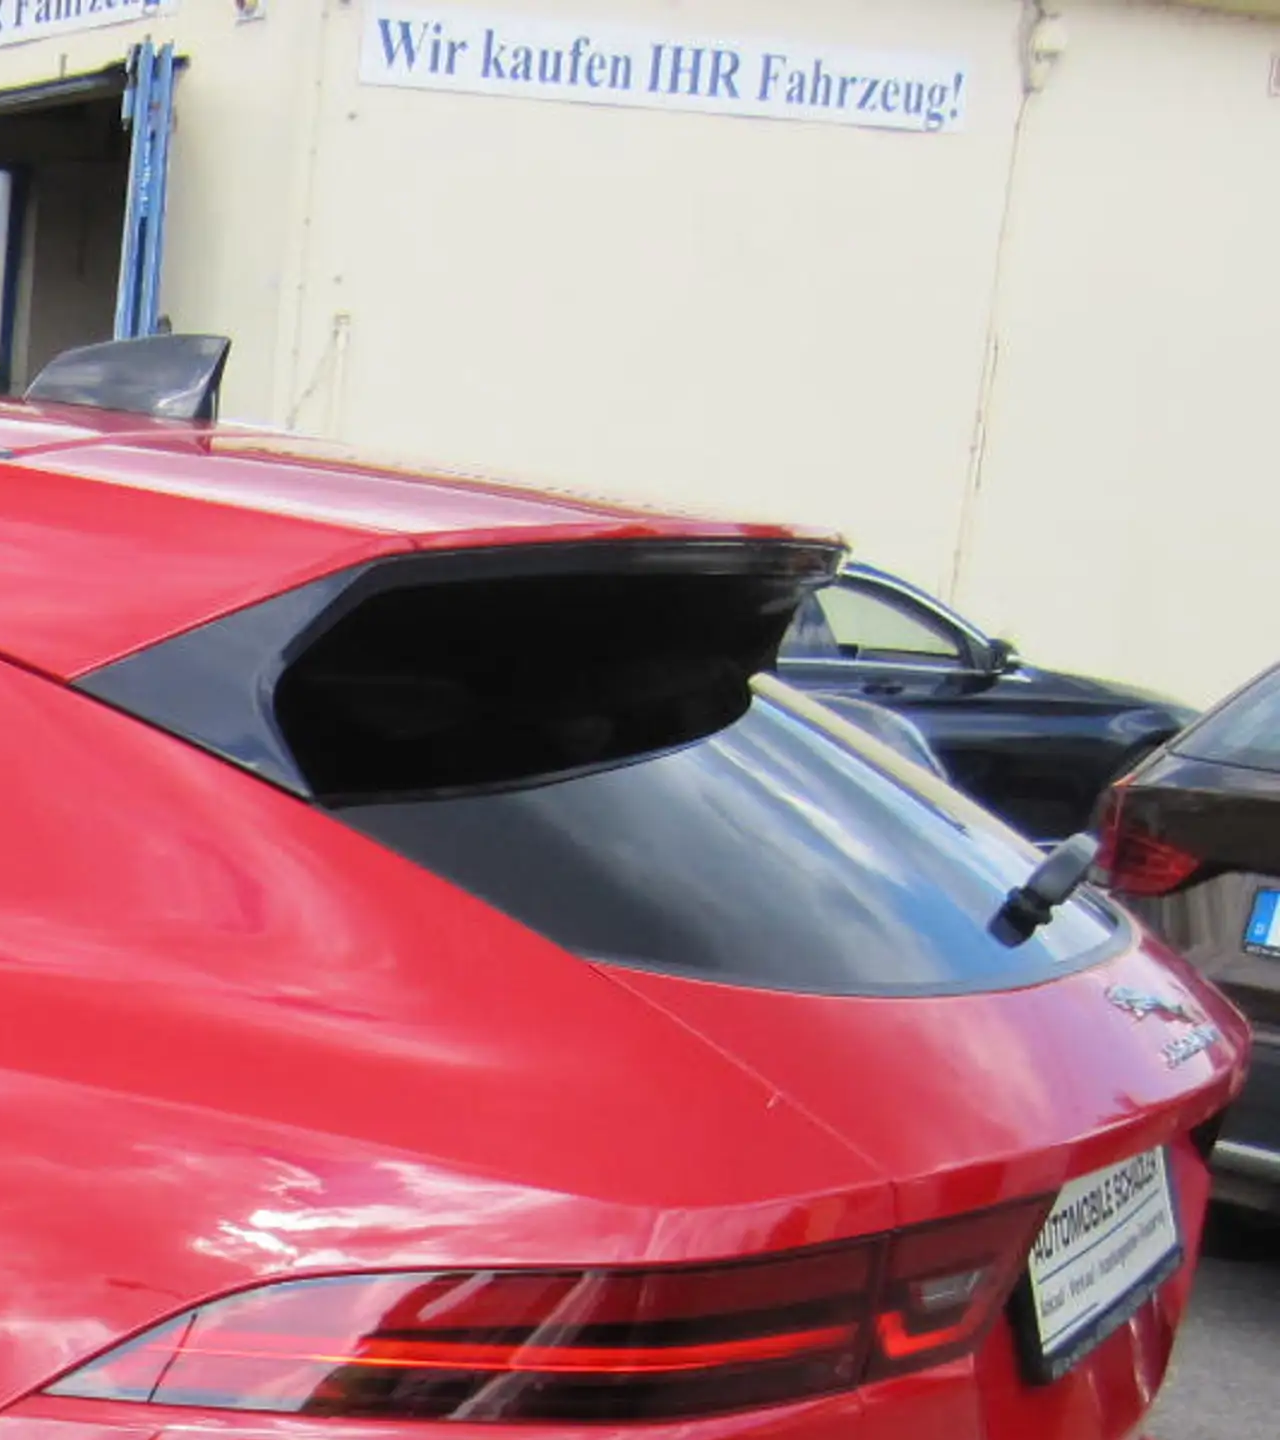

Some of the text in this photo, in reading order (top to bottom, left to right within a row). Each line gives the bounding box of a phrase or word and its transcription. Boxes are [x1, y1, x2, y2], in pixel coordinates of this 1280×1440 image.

[377, 17, 964, 129] Wir kaufen IHR Fahrzeug!
